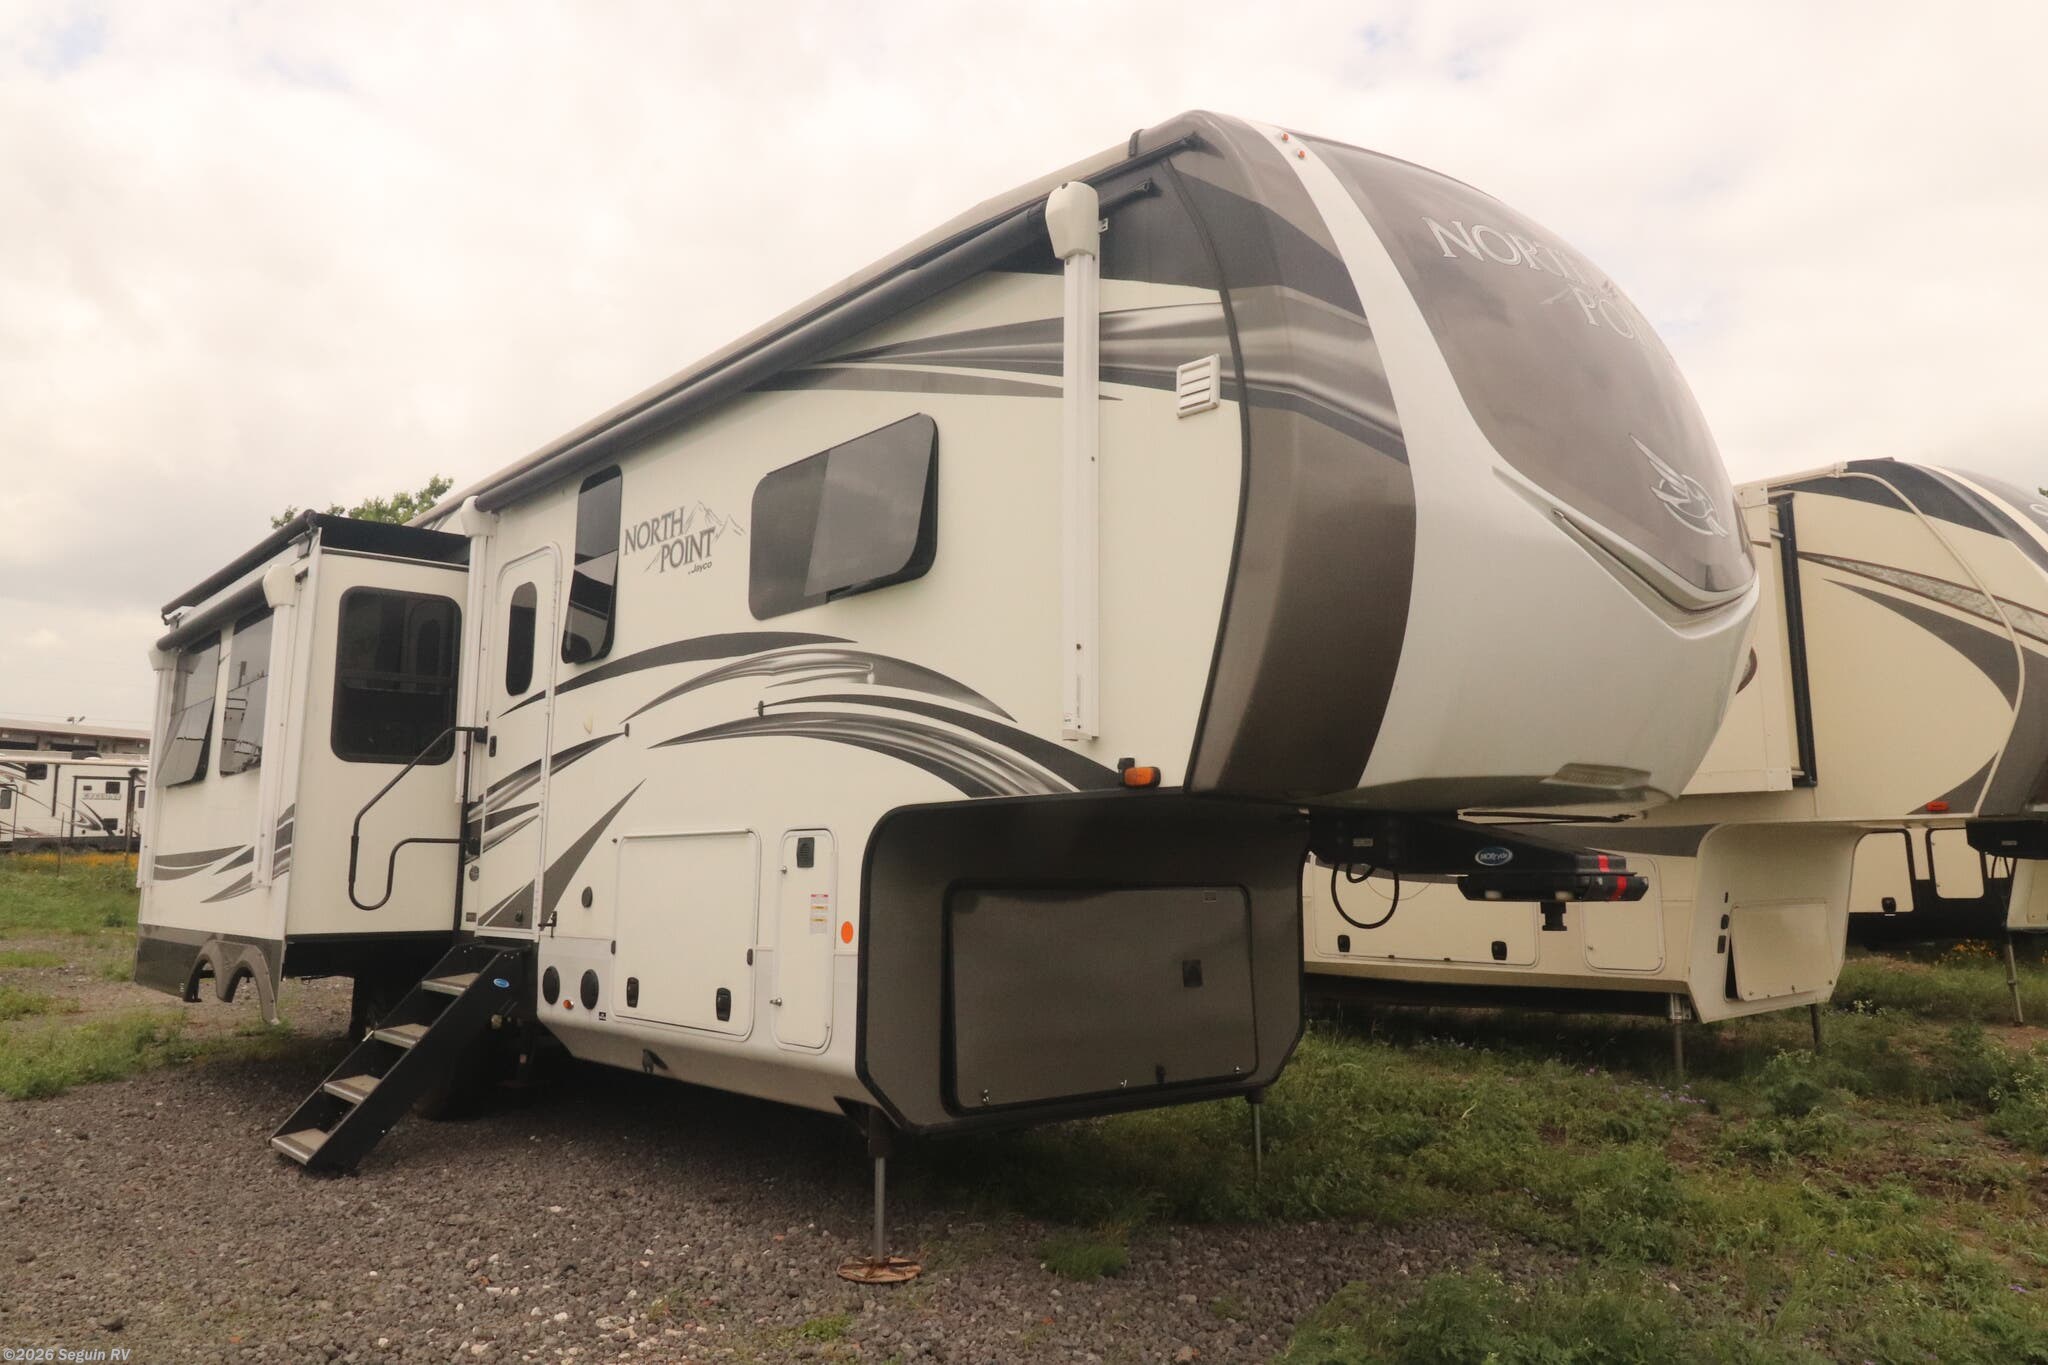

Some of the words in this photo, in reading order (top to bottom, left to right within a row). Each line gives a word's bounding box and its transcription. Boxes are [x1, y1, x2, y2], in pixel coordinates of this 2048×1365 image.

[623, 506, 685, 556] NORTH
[659, 527, 716, 574] POINT
[688, 560, 713, 575] Jayco
